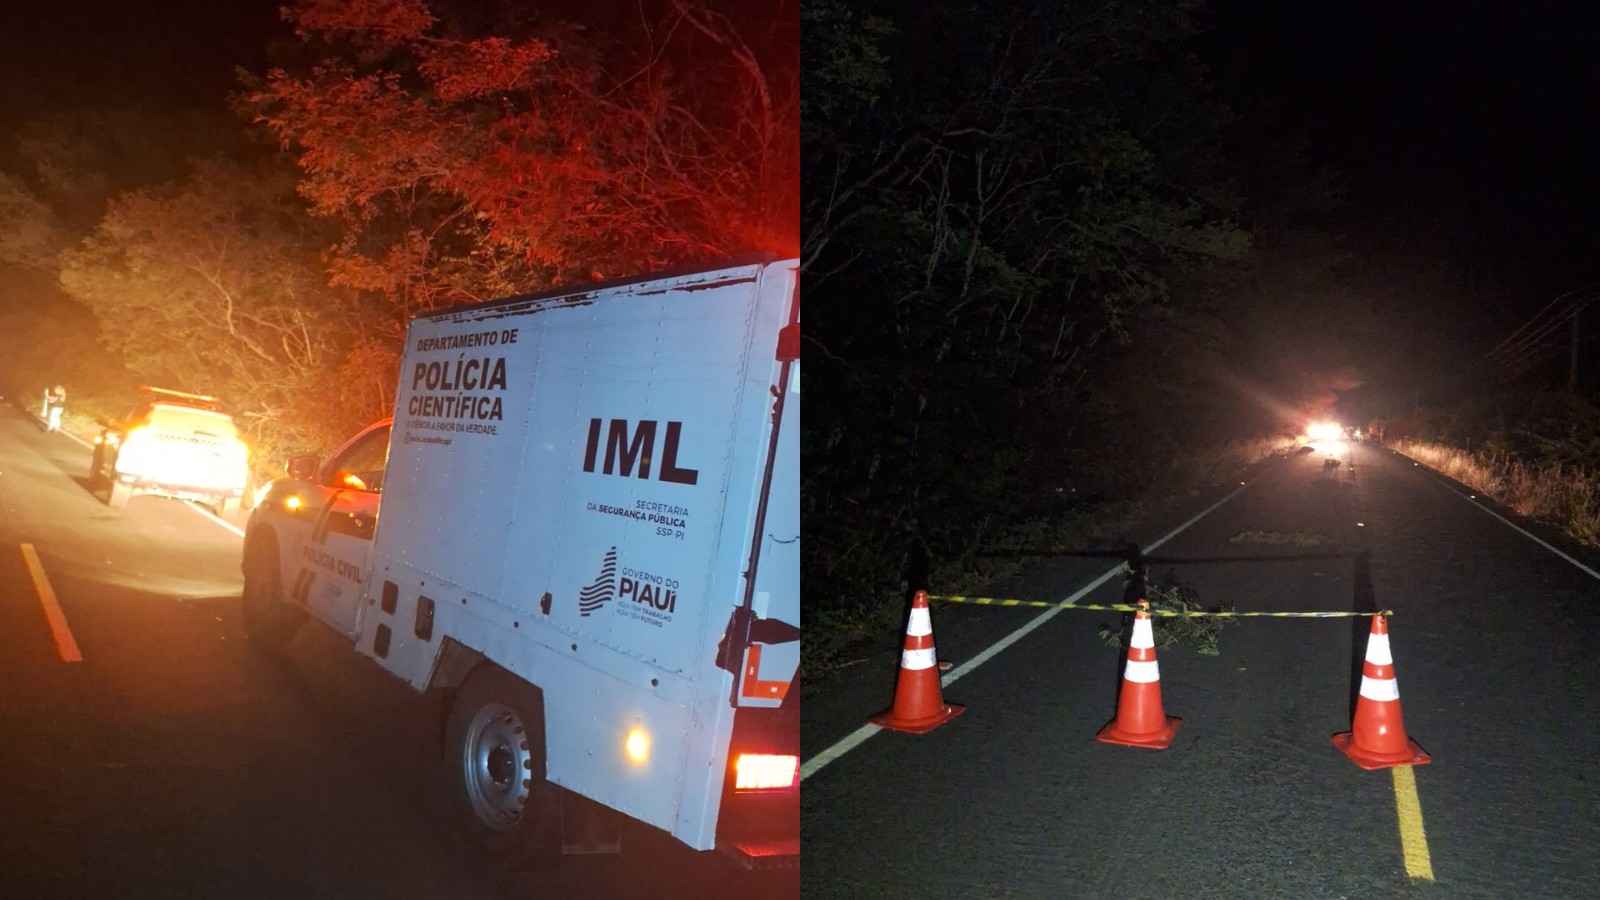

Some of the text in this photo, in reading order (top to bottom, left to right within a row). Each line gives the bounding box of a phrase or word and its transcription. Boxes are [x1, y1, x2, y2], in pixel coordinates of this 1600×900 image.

[417, 329, 518, 351] DEPARTAMENTO DE
[412, 352, 507, 391] POLÍCIA
[408, 392, 503, 421] CIENTÍFICA
[435, 422, 455, 431] FAVOR
[456, 423, 464, 432] DA
[583, 418, 699, 486] IML
[587, 502, 686, 528] DA SEGURANÇA PÚBLICA
[636, 500, 689, 517] SECRETARIA
[656, 527, 684, 540] SSP-PI
[338, 559, 362, 584] CIVIL
[622, 567, 679, 589] GOVERNO DO
[618, 577, 677, 614] PIAUÍ
[641, 616, 663, 628] FUTURO
[642, 608, 672, 622] TRABALHO
